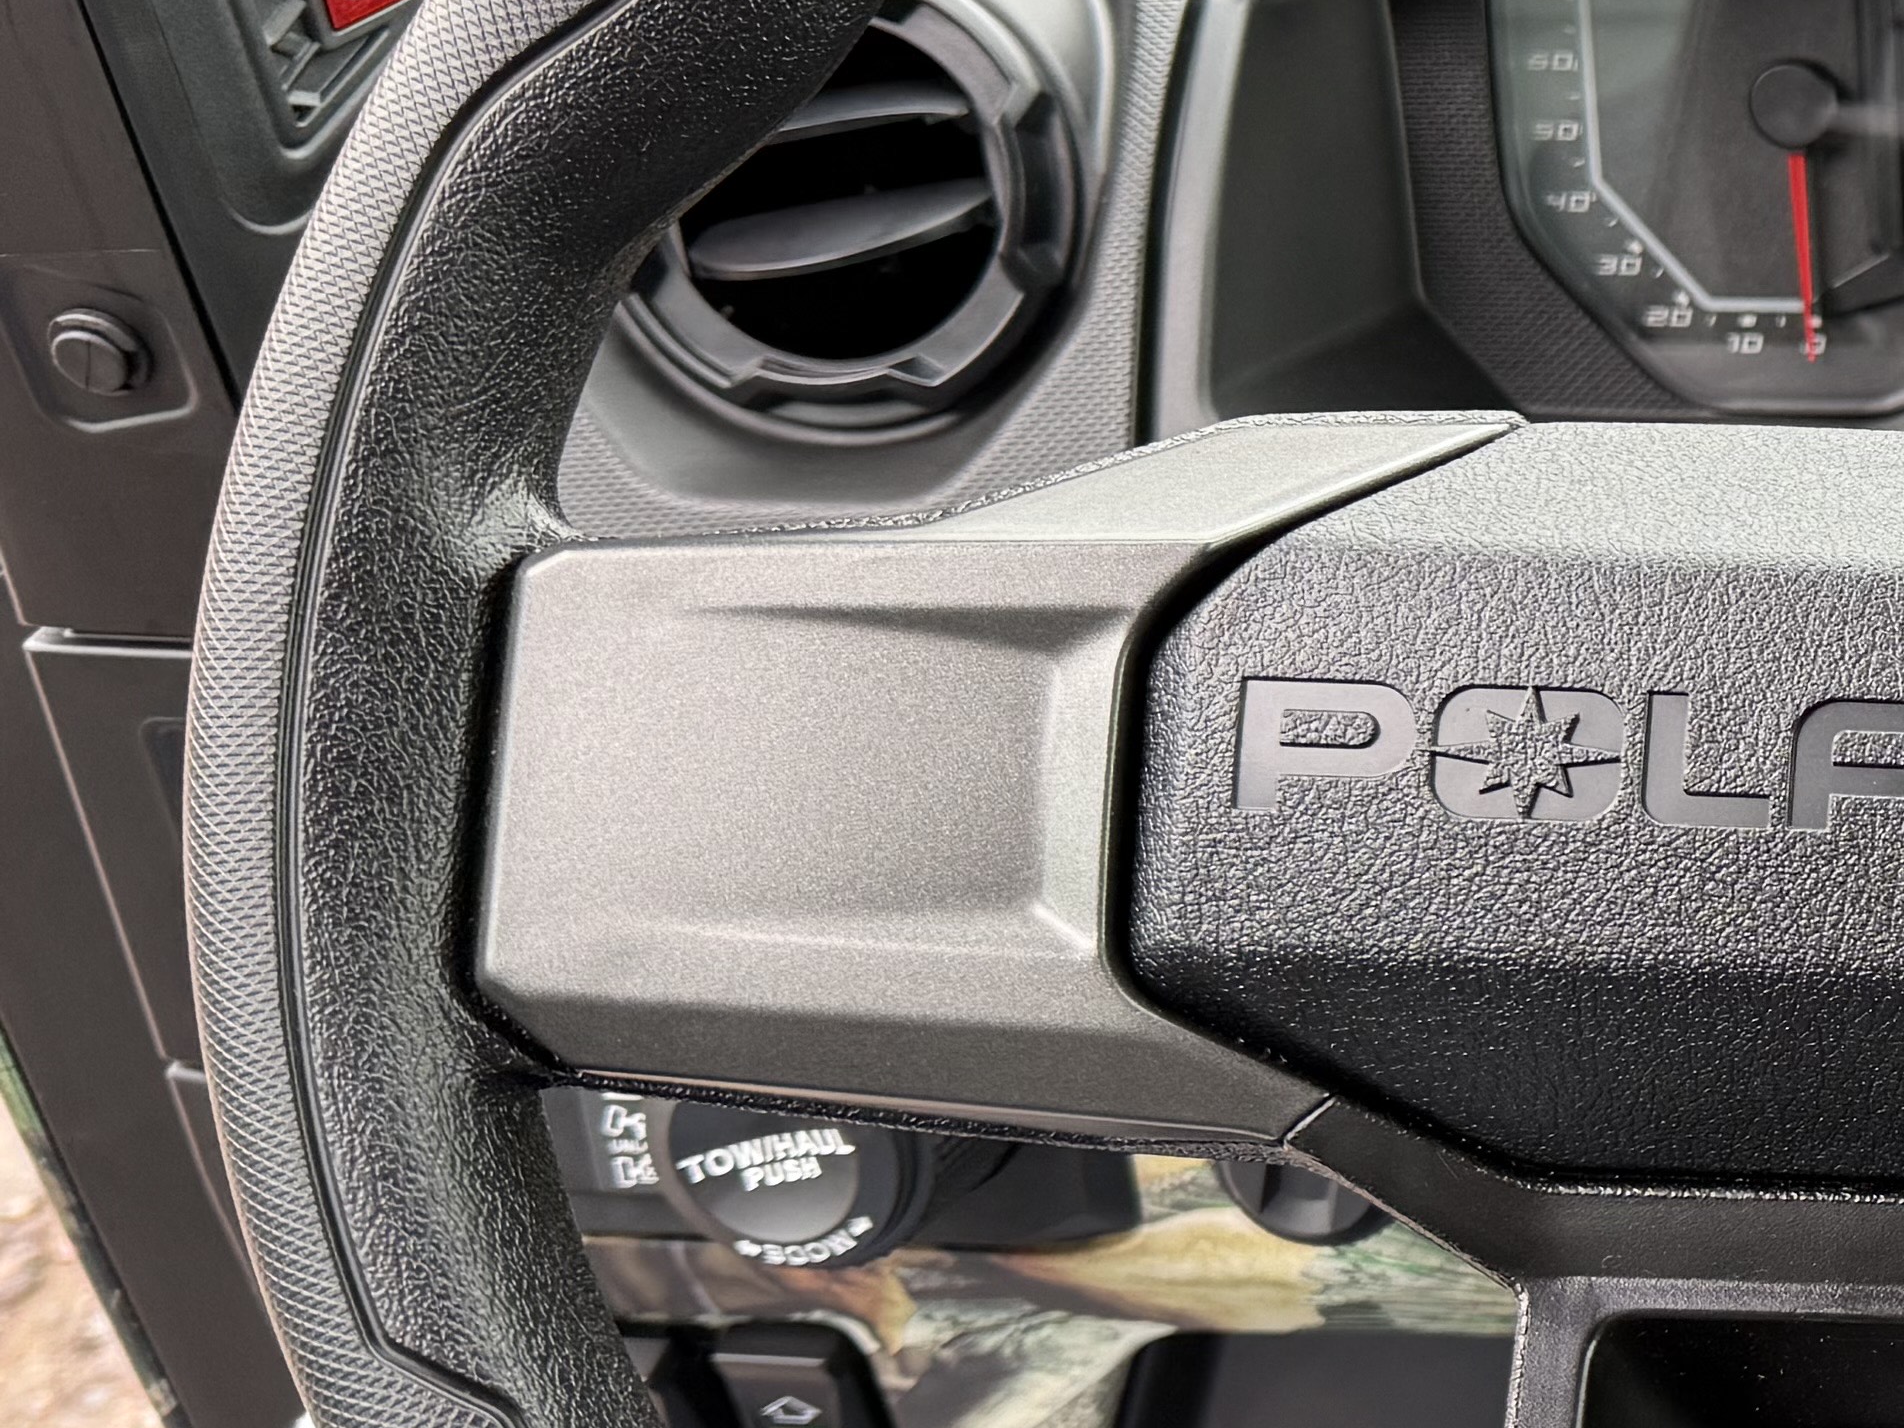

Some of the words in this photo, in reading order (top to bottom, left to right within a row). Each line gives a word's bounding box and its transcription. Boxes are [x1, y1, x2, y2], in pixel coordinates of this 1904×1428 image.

[1532, 119, 1579, 141] 50
[1547, 190, 1591, 212] 40
[1598, 254, 1642, 276] 30
[1643, 305, 1694, 328] 20
[1726, 332, 1764, 354] 10
[676, 1128, 856, 1184] TOW/HAUL
[740, 1156, 823, 1192] PUSH
